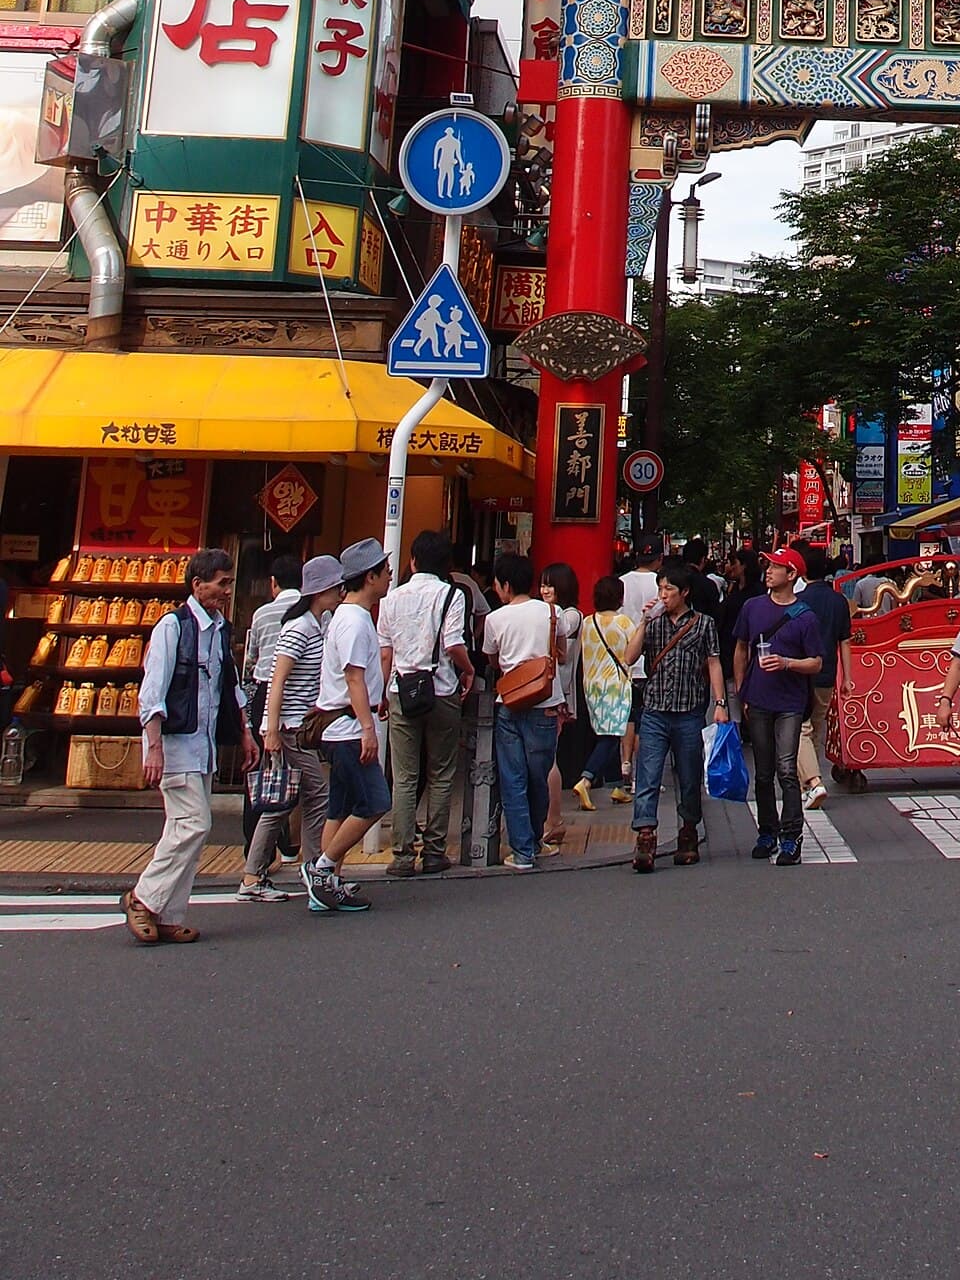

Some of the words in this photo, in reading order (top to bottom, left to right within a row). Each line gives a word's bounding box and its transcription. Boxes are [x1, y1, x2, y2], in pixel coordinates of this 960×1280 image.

[145, 201, 270, 238] 中華街
[142, 239, 265, 262] 大通り入口
[303, 211, 342, 271] 入口
[101, 421, 178, 446] 大粒甘栗
[633, 461, 655, 480] 30
